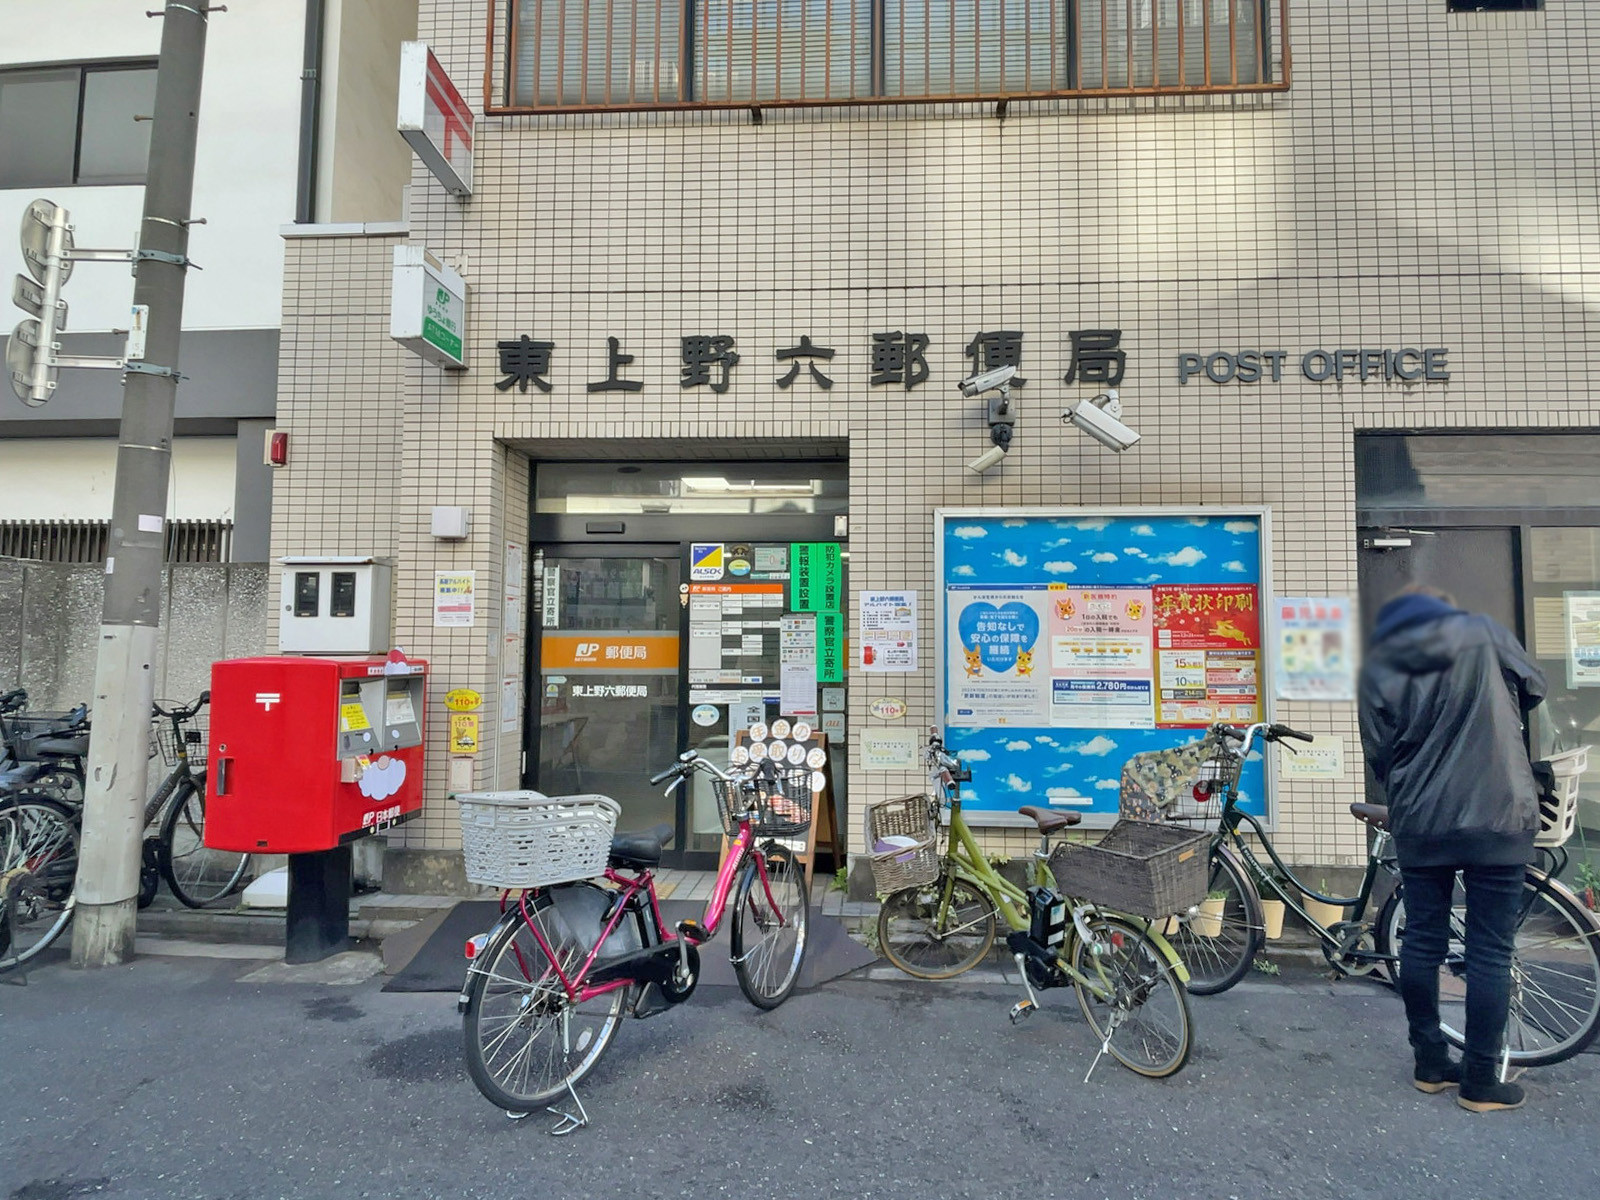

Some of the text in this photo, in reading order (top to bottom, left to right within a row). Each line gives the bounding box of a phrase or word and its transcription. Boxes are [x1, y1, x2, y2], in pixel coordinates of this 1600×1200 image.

[495, 330, 1126, 392] 東上野六郵便局
[1179, 348, 1449, 384] POST OFFICE
[799, 545, 810, 610] 警報装置設置
[825, 545, 836, 610] 防犯カメラ設置店
[1160, 593, 1253, 612] 年賀状印刷
[976, 621, 1025, 632] 告知なしで
[824, 616, 835, 679] 警察官立寄所
[970, 633, 1028, 643] 安心の保障を
[576, 643, 647, 660] JP 郵便局
[572, 685, 648, 698] 東上野六郵便局
[752, 721, 808, 739] 年金の
